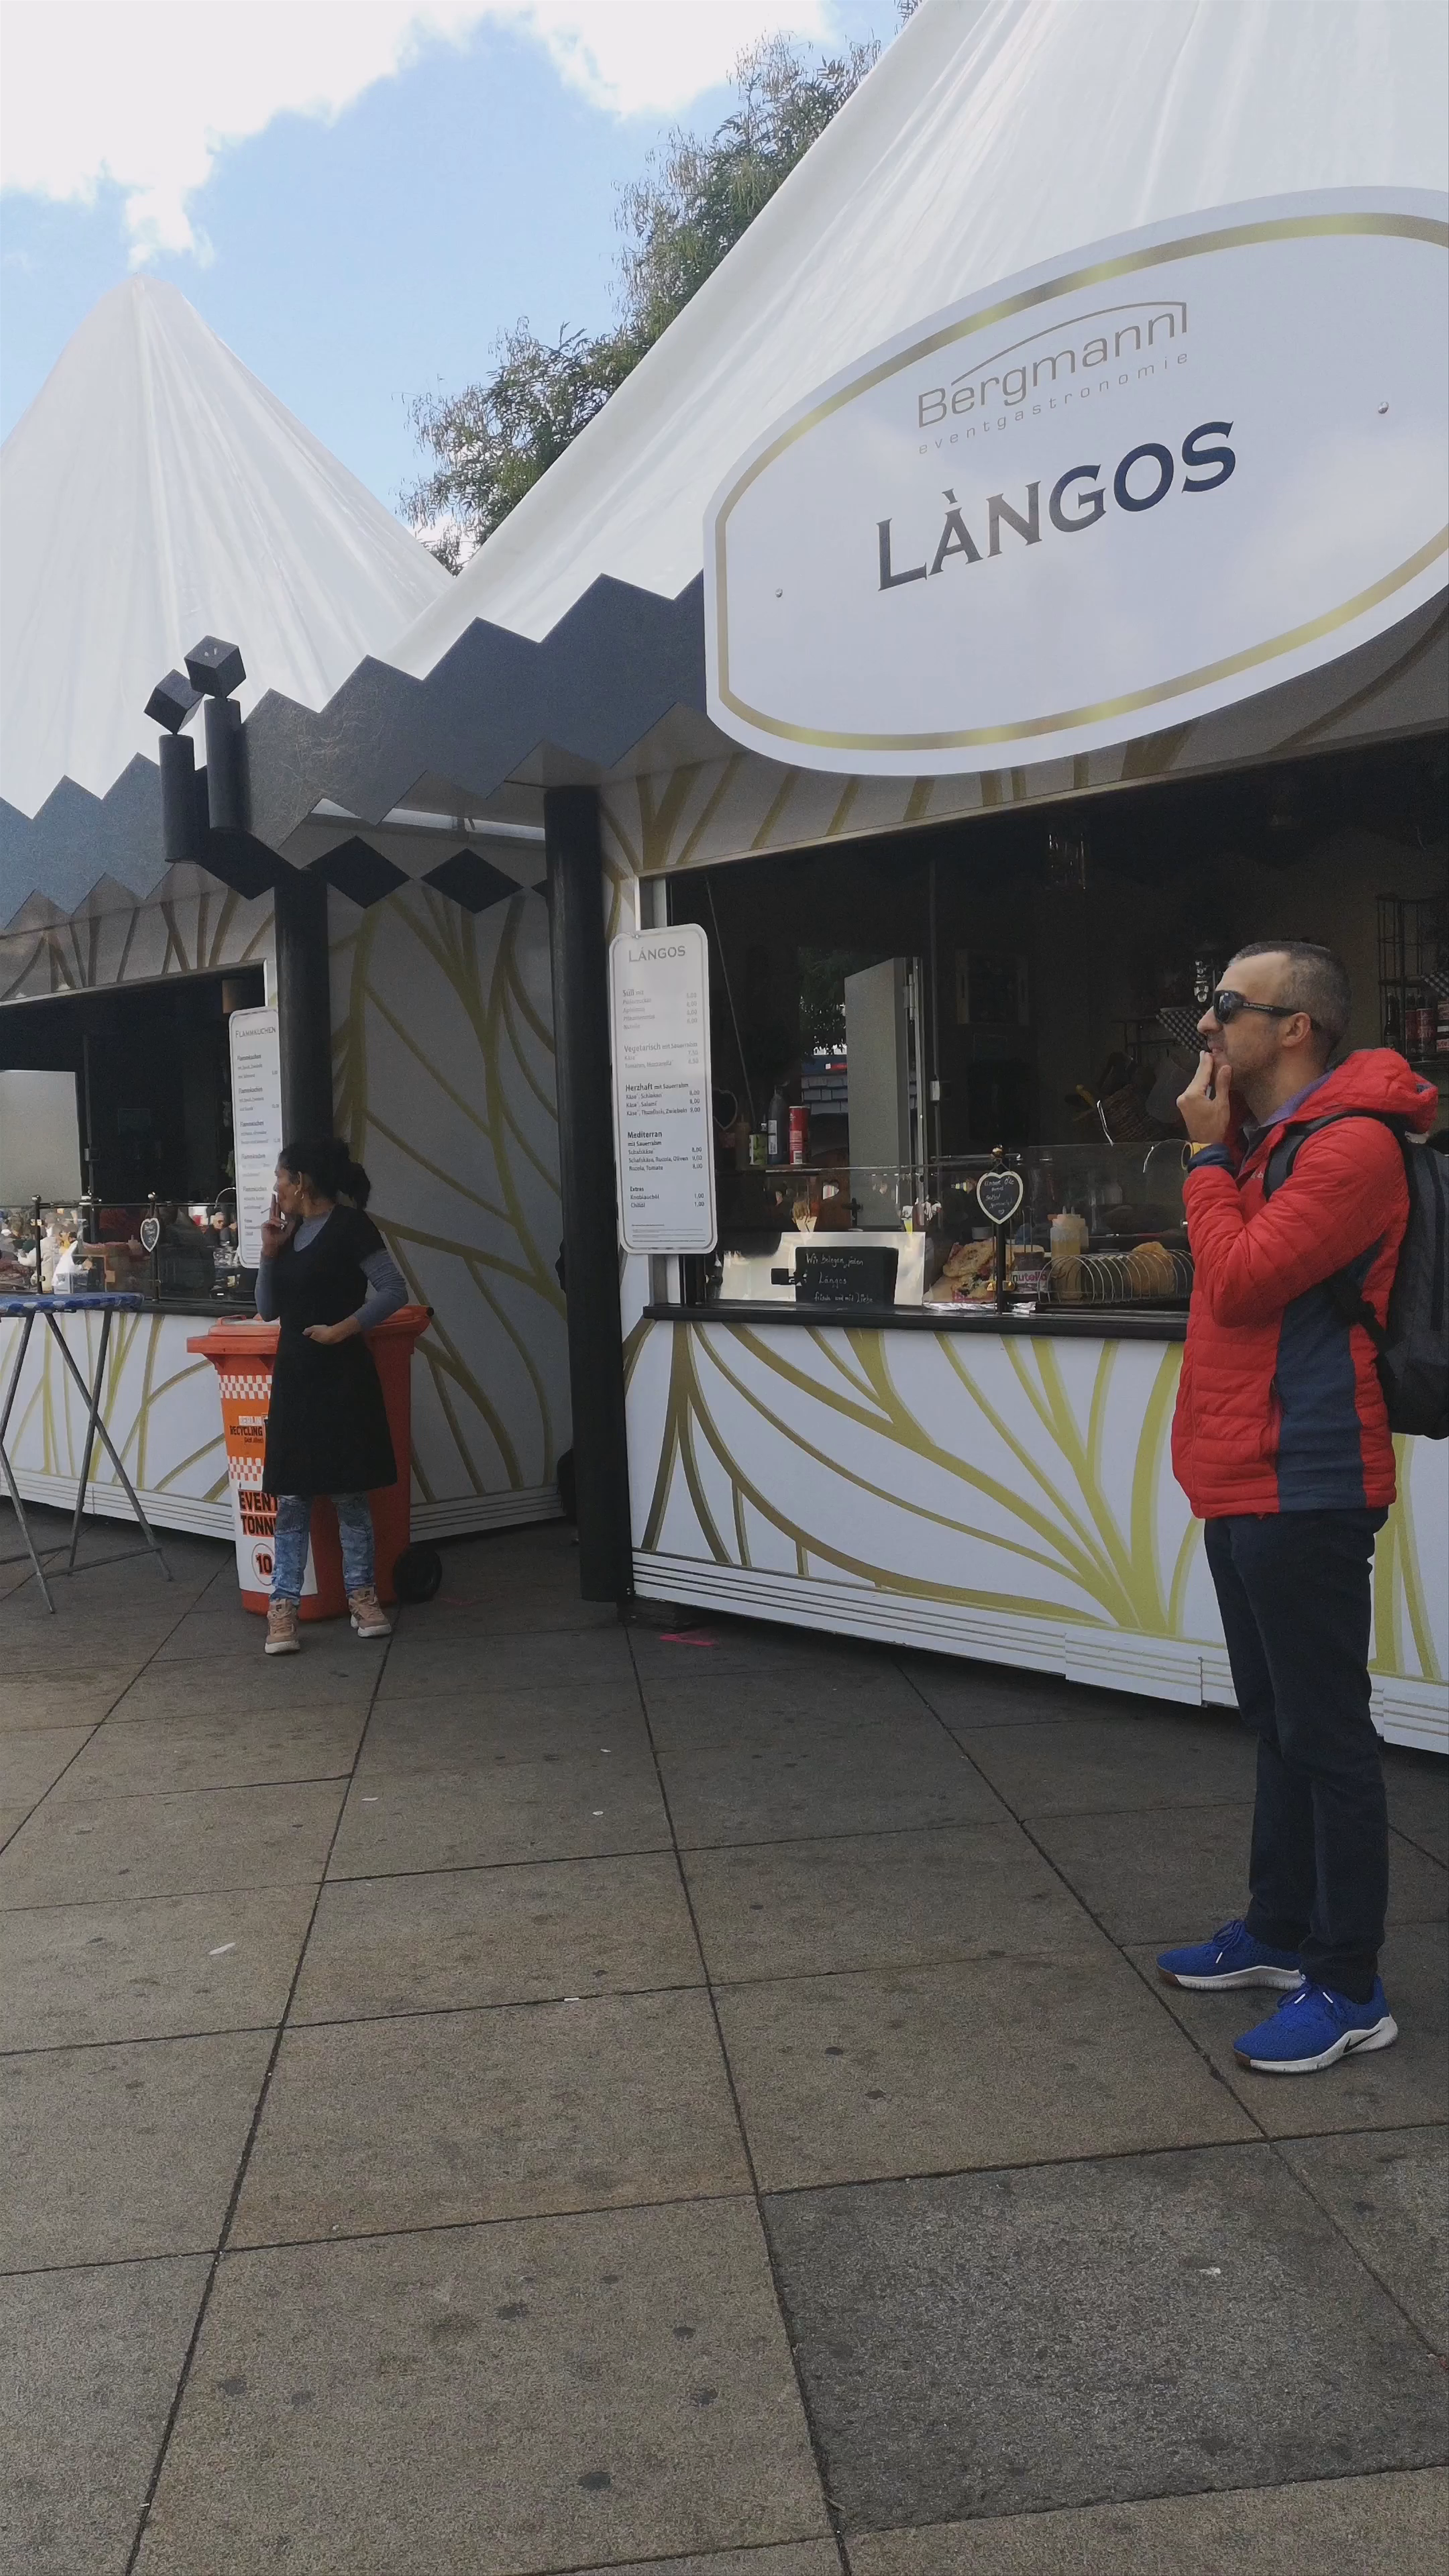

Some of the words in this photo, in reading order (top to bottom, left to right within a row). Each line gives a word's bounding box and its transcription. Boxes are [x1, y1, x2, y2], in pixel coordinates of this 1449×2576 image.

[918, 305, 1187, 428] Bergmann
[918, 353, 1188, 454] eventgastronomie
[876, 421, 1236, 591] LÀNGOS
[629, 945, 685, 963] LÁNGOS
[624, 1042, 660, 1053] Vegetarisch
[625, 1083, 653, 1092] Herzhaft
[806, 1253, 818, 1264] Wir
[229, 1425, 263, 1436] RECYCLING
[240, 1514, 277, 1536] TONN
